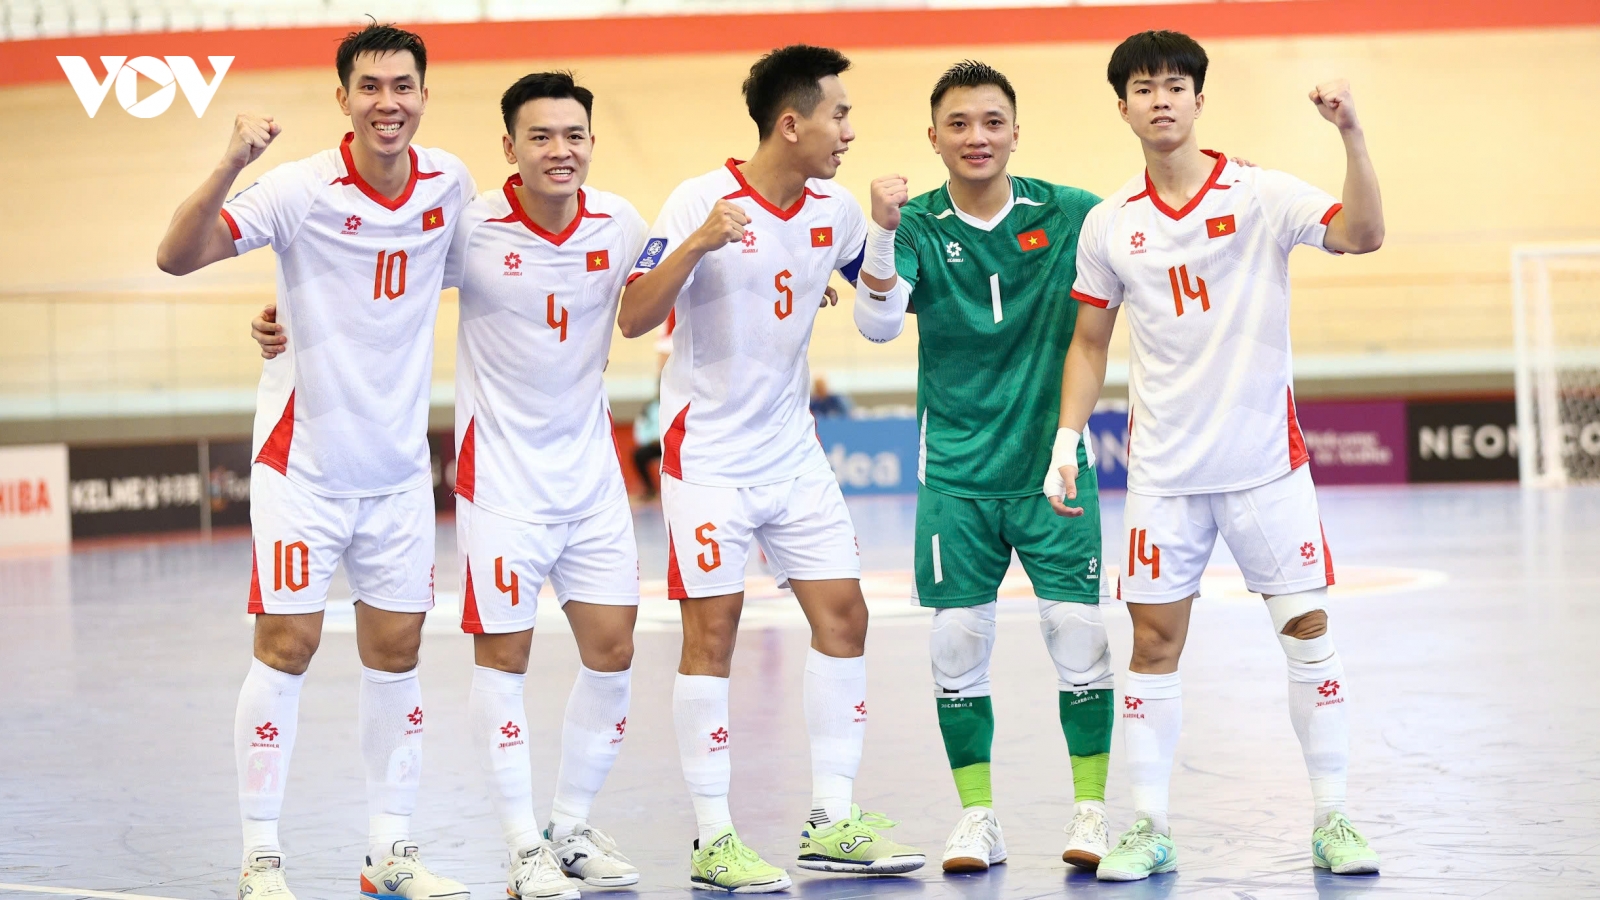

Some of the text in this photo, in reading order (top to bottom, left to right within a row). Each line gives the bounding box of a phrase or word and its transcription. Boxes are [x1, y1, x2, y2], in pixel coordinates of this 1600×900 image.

[374, 249, 408, 300] 10
[774, 269, 793, 320] 5
[989, 273, 1003, 324] 1
[1168, 264, 1210, 317] 14
[547, 293, 568, 343] 4
[274, 540, 309, 592] 10
[695, 522, 721, 572] 5
[931, 533, 943, 584] 1
[1129, 528, 1160, 580] 14
[495, 556, 519, 606] 4
